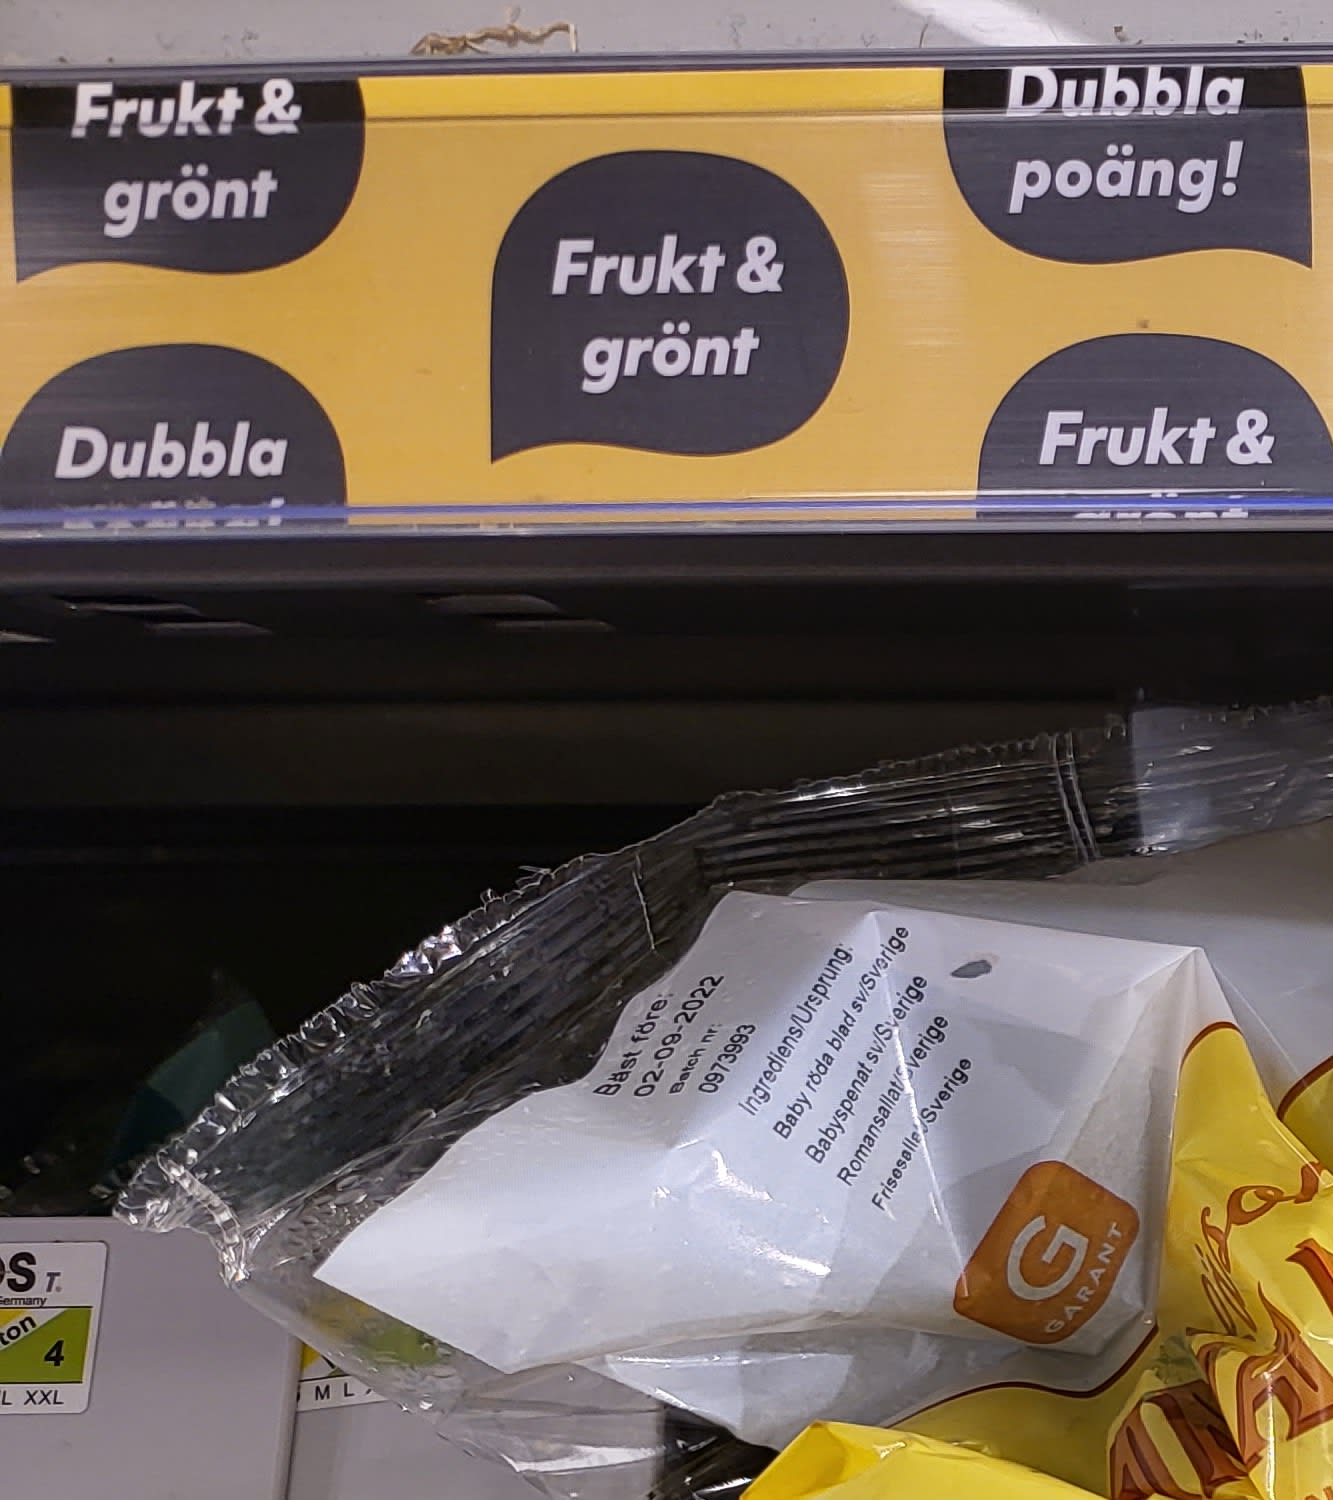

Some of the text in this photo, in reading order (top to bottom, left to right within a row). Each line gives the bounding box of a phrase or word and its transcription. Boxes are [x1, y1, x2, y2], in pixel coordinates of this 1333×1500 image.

[72, 79, 303, 137] Frukt &
[1005, 66, 1244, 118] Dubbla
[103, 165, 278, 238] grönt
[1008, 142, 1244, 214] poäng!
[551, 234, 784, 295] Frukt &
[581, 321, 760, 393] grönt
[55, 421, 289, 479] Dubbla
[1039, 407, 1275, 467] Frukt &
[593, 993, 674, 1096] Bäst före:
[634, 975, 725, 1098] 02-09-2022
[698, 1023, 757, 1094] 0973993
[738, 943, 854, 1116] Ingrediens/Ursprung:
[772, 925, 909, 1140] Baby röda blad sv/Sverige
[668, 1048, 706, 1095] Batch
[804, 1060, 873, 1164] Babyspenat
[1007, 1215, 1089, 1300] G
[1044, 1221, 1122, 1333] GARANT
[44, 1340, 65, 1367] 4
[24, 1389, 64, 1405] XXL
